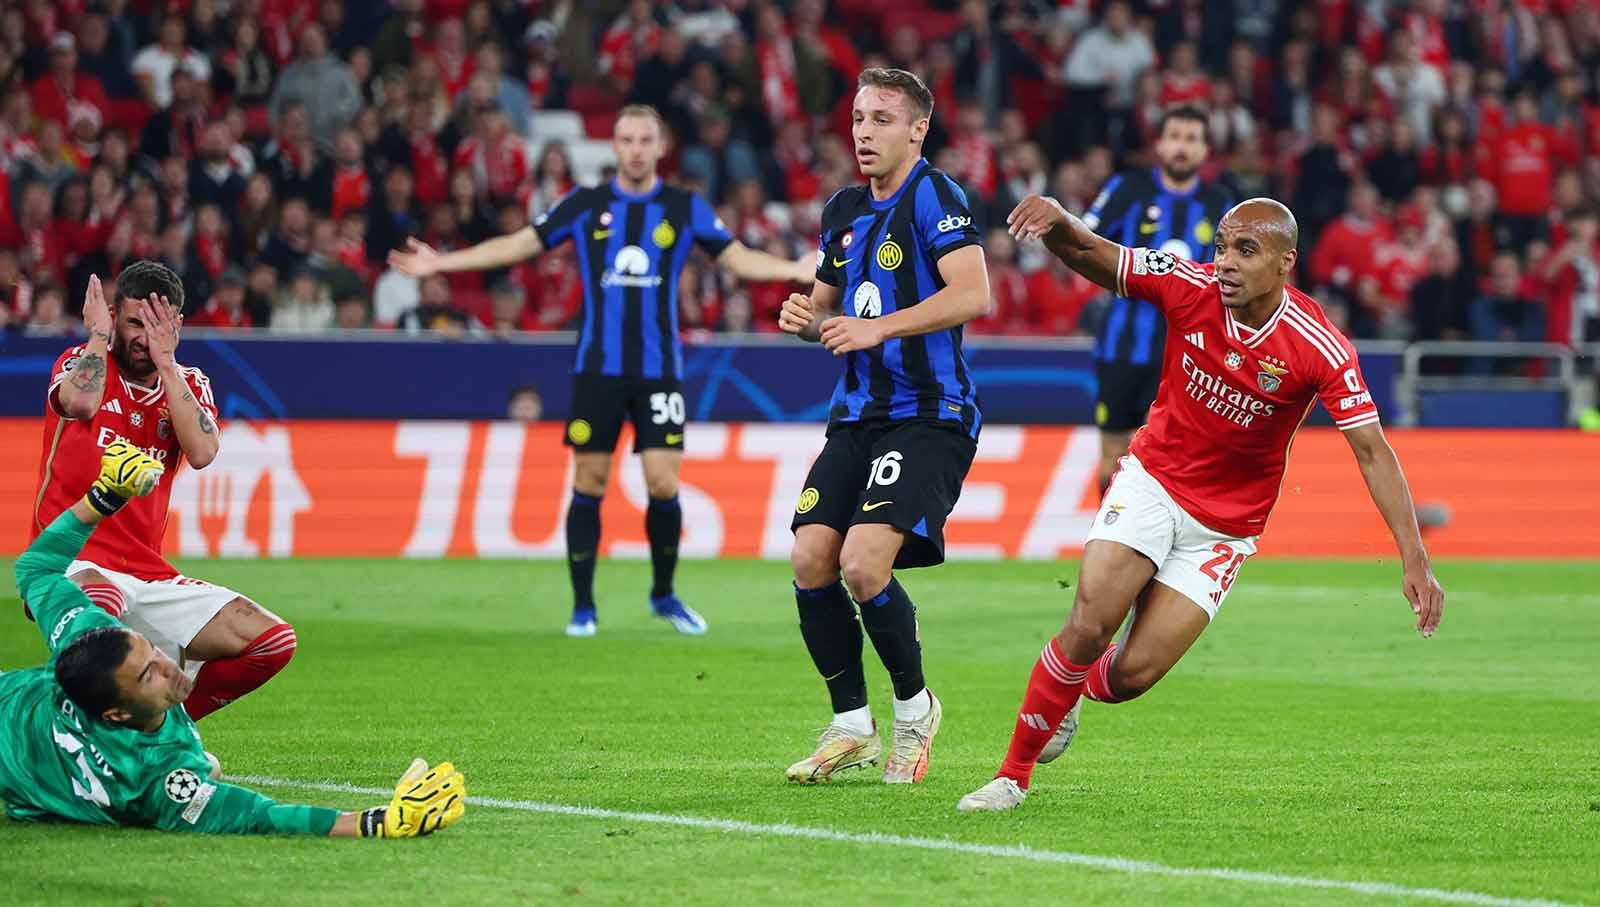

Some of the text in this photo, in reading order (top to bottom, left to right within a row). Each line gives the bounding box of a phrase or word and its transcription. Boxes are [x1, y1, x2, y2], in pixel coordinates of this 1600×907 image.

[650, 392, 686, 425] 30
[1182, 352, 1275, 417] Emirates
[1185, 381, 1254, 428] FLY BETTER
[394, 421, 828, 559] JUST
[866, 450, 903, 490] 16
[1200, 543, 1244, 592] 20
